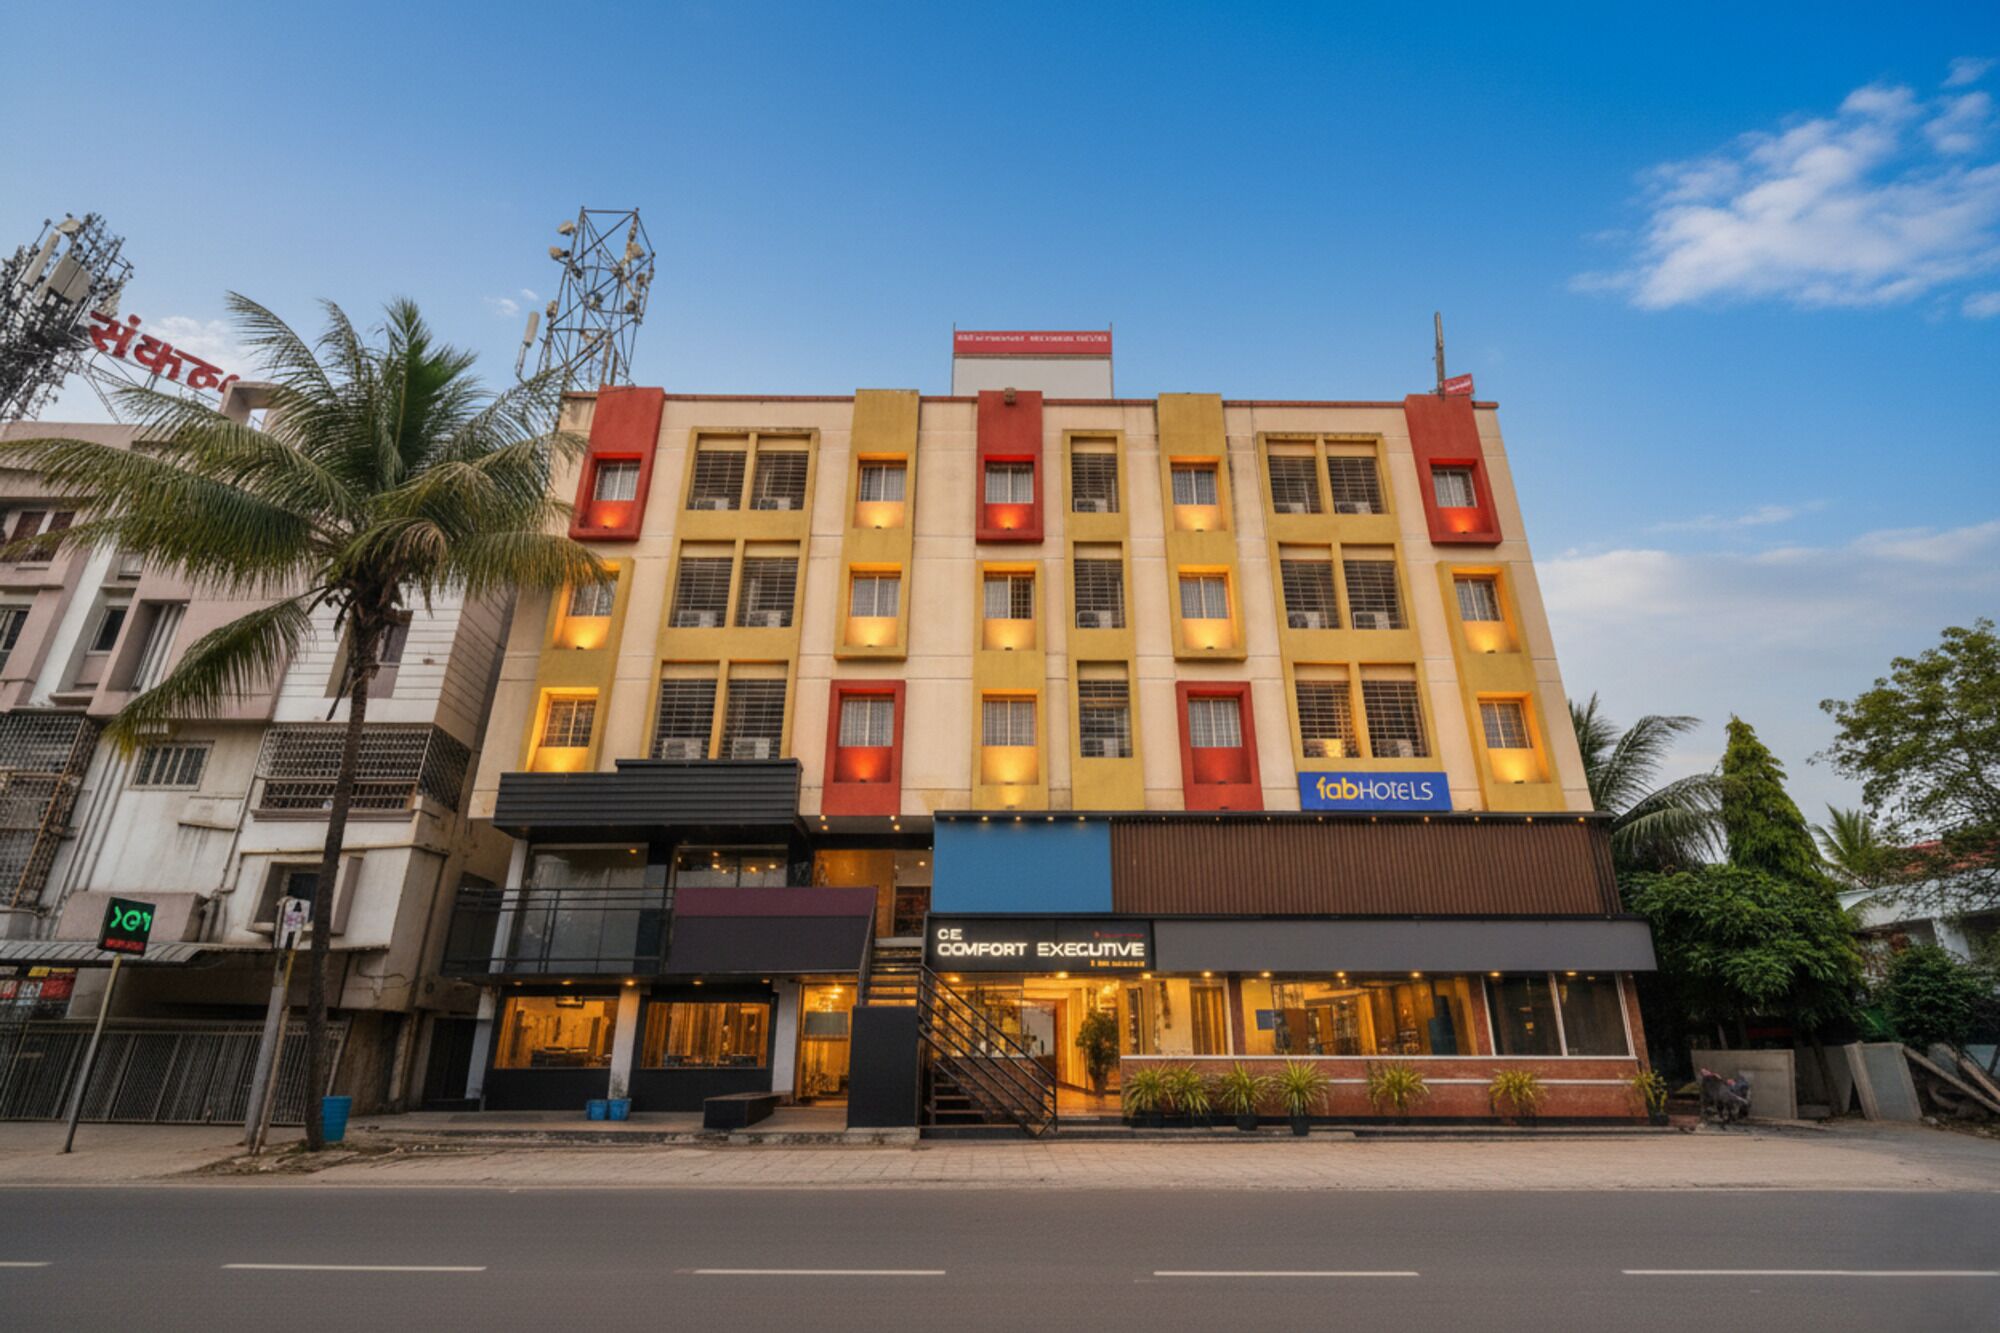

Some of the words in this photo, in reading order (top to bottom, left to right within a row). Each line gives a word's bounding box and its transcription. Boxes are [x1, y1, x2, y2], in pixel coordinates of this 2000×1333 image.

[937, 928, 962, 940] CE
[937, 942, 1028, 956] COMFORT
[1037, 942, 1145, 957] EXECUTIVE
